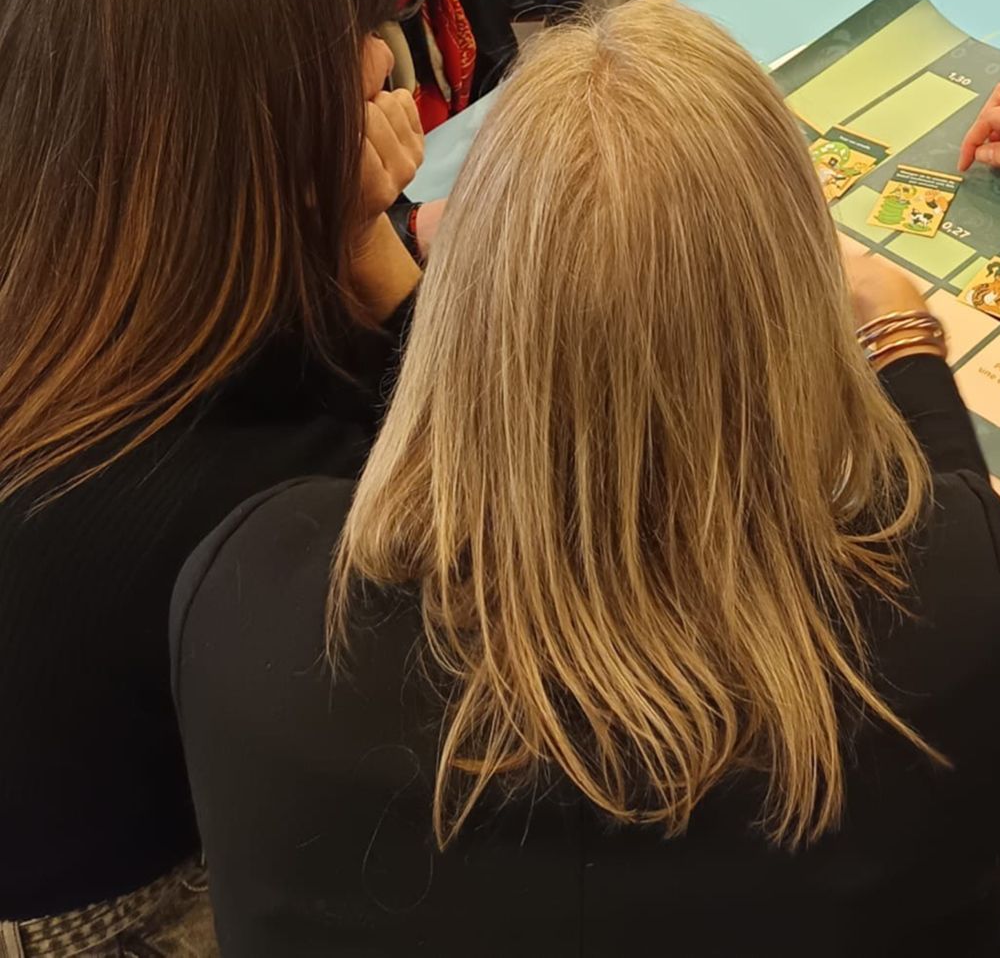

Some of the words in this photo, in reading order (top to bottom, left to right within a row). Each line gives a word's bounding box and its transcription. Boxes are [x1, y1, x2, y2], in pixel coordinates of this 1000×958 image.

[948, 72, 972, 86] 1,30
[942, 221, 971, 239] 0,27
[978, 366, 996, 379] une
